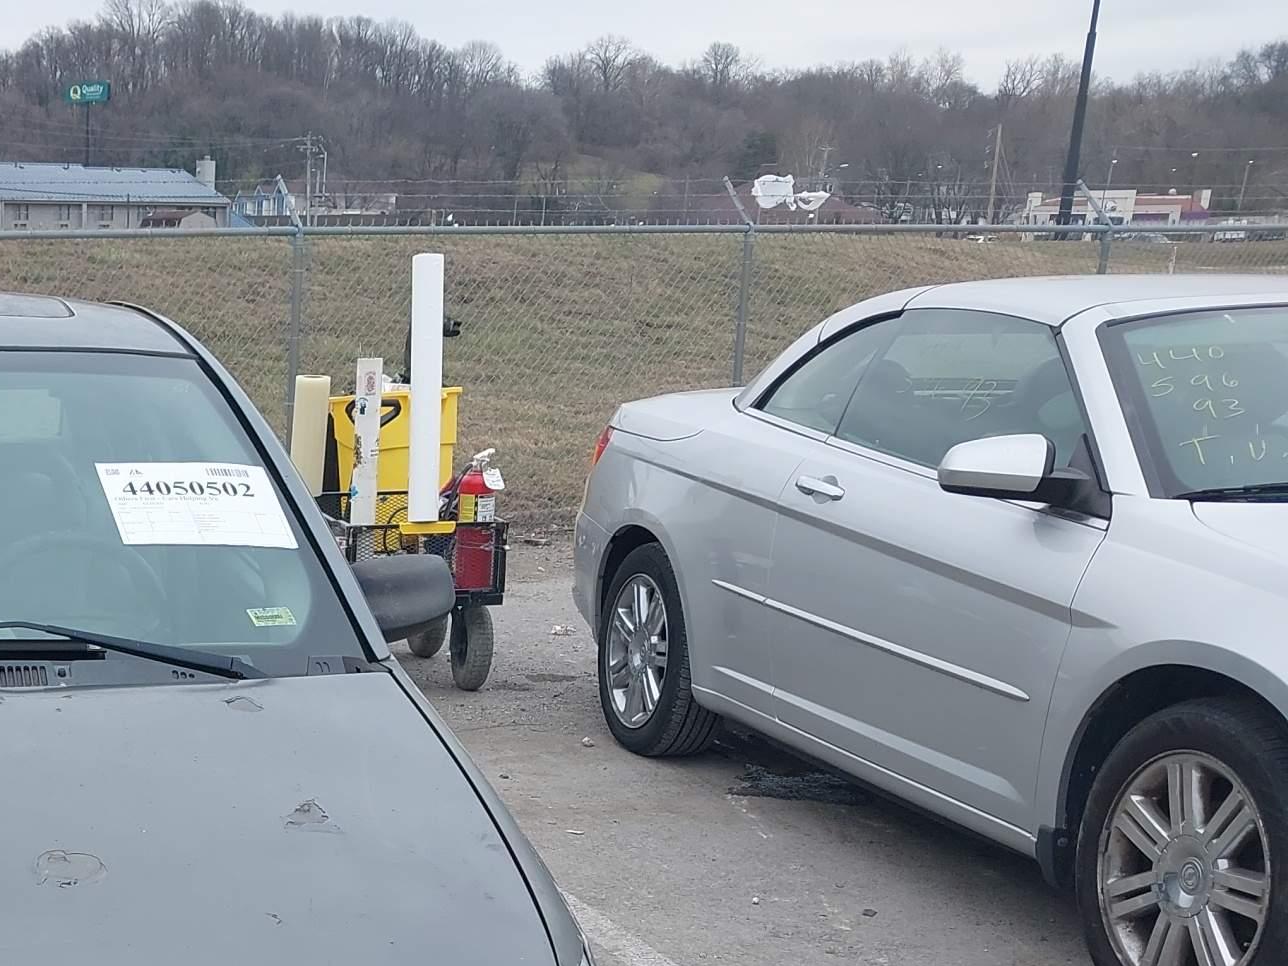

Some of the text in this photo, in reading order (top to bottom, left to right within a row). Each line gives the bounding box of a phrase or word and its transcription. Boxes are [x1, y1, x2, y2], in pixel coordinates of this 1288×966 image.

[82, 84, 104, 94] Quality
[1137, 345, 1225, 369] 440
[1192, 398, 1247, 420] 93
[122, 480, 255, 497] 44050502
